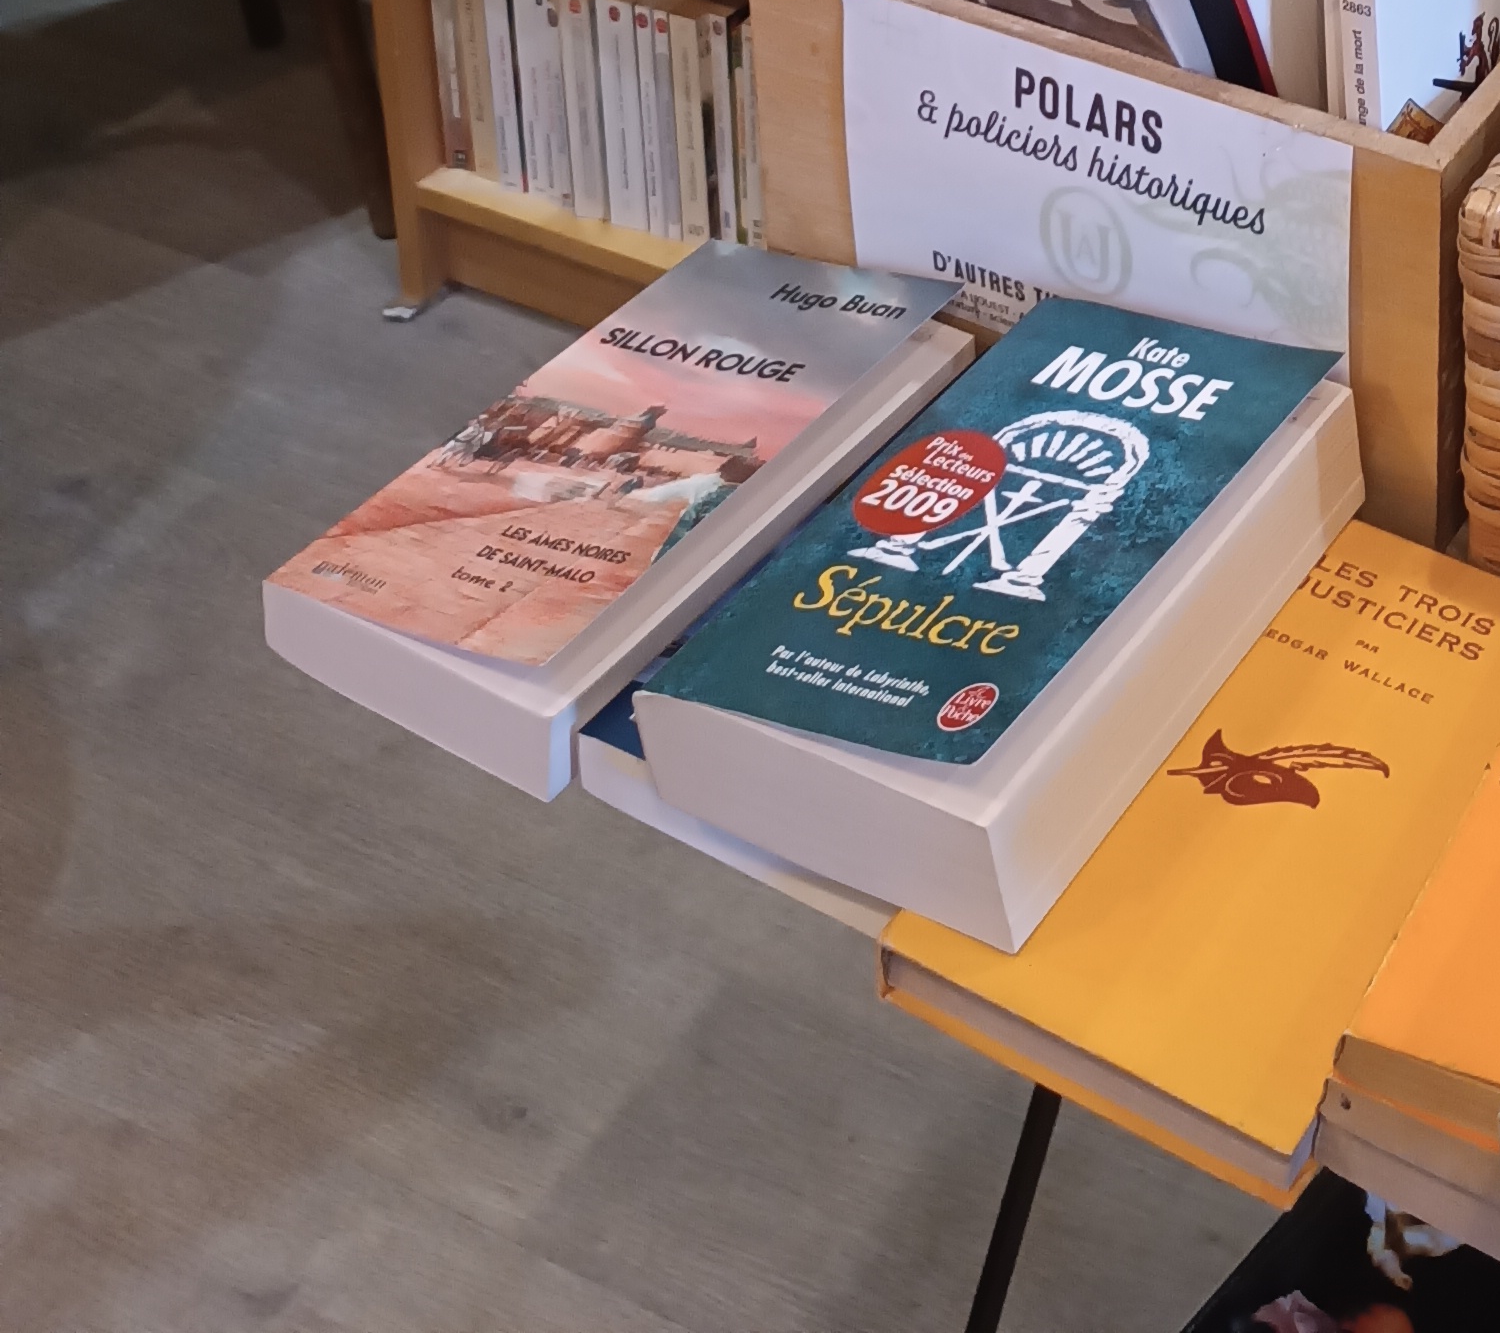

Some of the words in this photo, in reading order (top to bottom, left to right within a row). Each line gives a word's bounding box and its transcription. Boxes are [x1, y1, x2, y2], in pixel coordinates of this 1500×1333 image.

[1341, 0, 1372, 17] 2863
[1351, 29, 1363, 61] mort
[1353, 63, 1364, 76] la
[1354, 77, 1366, 95] de
[1014, 66, 1164, 154] POLARS
[917, 88, 939, 126] &
[943, 96, 1079, 173] policiers
[1087, 144, 1267, 236] historiques
[931, 249, 1026, 302] D'AUTRES
[769, 282, 837, 317] Hugo
[838, 290, 906, 324] Buan
[599, 325, 703, 365] SILLON
[700, 347, 806, 384] ROUGE
[1127, 336, 1190, 371] Kate
[1030, 343, 1233, 422] MOSSE
[922, 445, 997, 483] Lecteurs
[925, 435, 964, 457] Prix
[861, 478, 963, 526] 2009
[888, 464, 975, 500] Sélection
[475, 544, 501, 561] DE
[499, 551, 597, 584] SAINT-MALO
[500, 523, 530, 543] LES
[572, 542, 632, 565] NOIRES
[450, 565, 495, 590] tome
[1315, 552, 1379, 591] LES
[1398, 584, 1498, 637] TROIS
[793, 561, 1021, 658] Sépulcre
[770, 644, 796, 662] Par
[794, 649, 846, 675] l'auteur
[844, 663, 863, 679] de
[1264, 626, 1330, 662] EDGAR
[1343, 657, 1436, 705] WALLACE
[1355, 638, 1380, 655] PAR
[765, 659, 833, 689] best-seller
[831, 678, 916, 708] international
